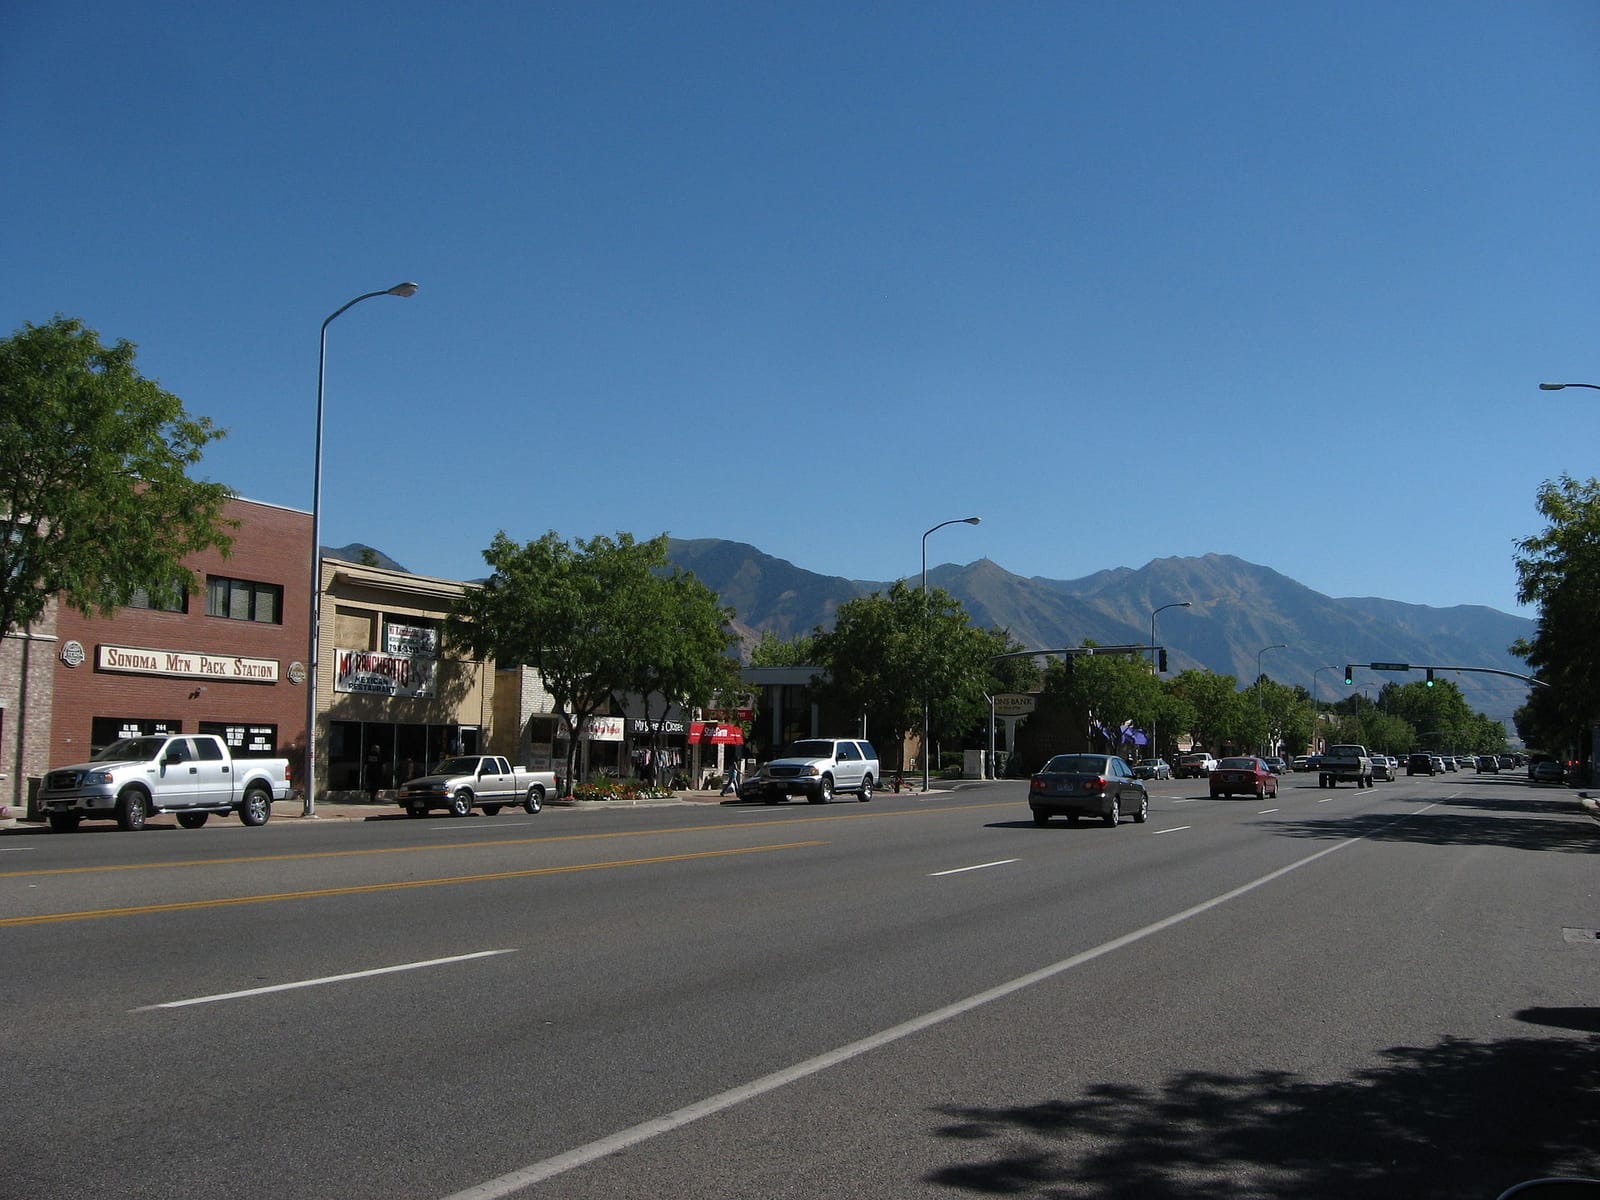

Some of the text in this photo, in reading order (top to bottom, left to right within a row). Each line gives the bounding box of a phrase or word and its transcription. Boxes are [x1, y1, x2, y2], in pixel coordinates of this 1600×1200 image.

[108, 648, 157, 670] SONOMA
[200, 658, 226, 675] PACK
[233, 660, 273, 678] STATION
[355, 676, 388, 684] MEXICAN
[349, 684, 394, 694] RESTAURANT
